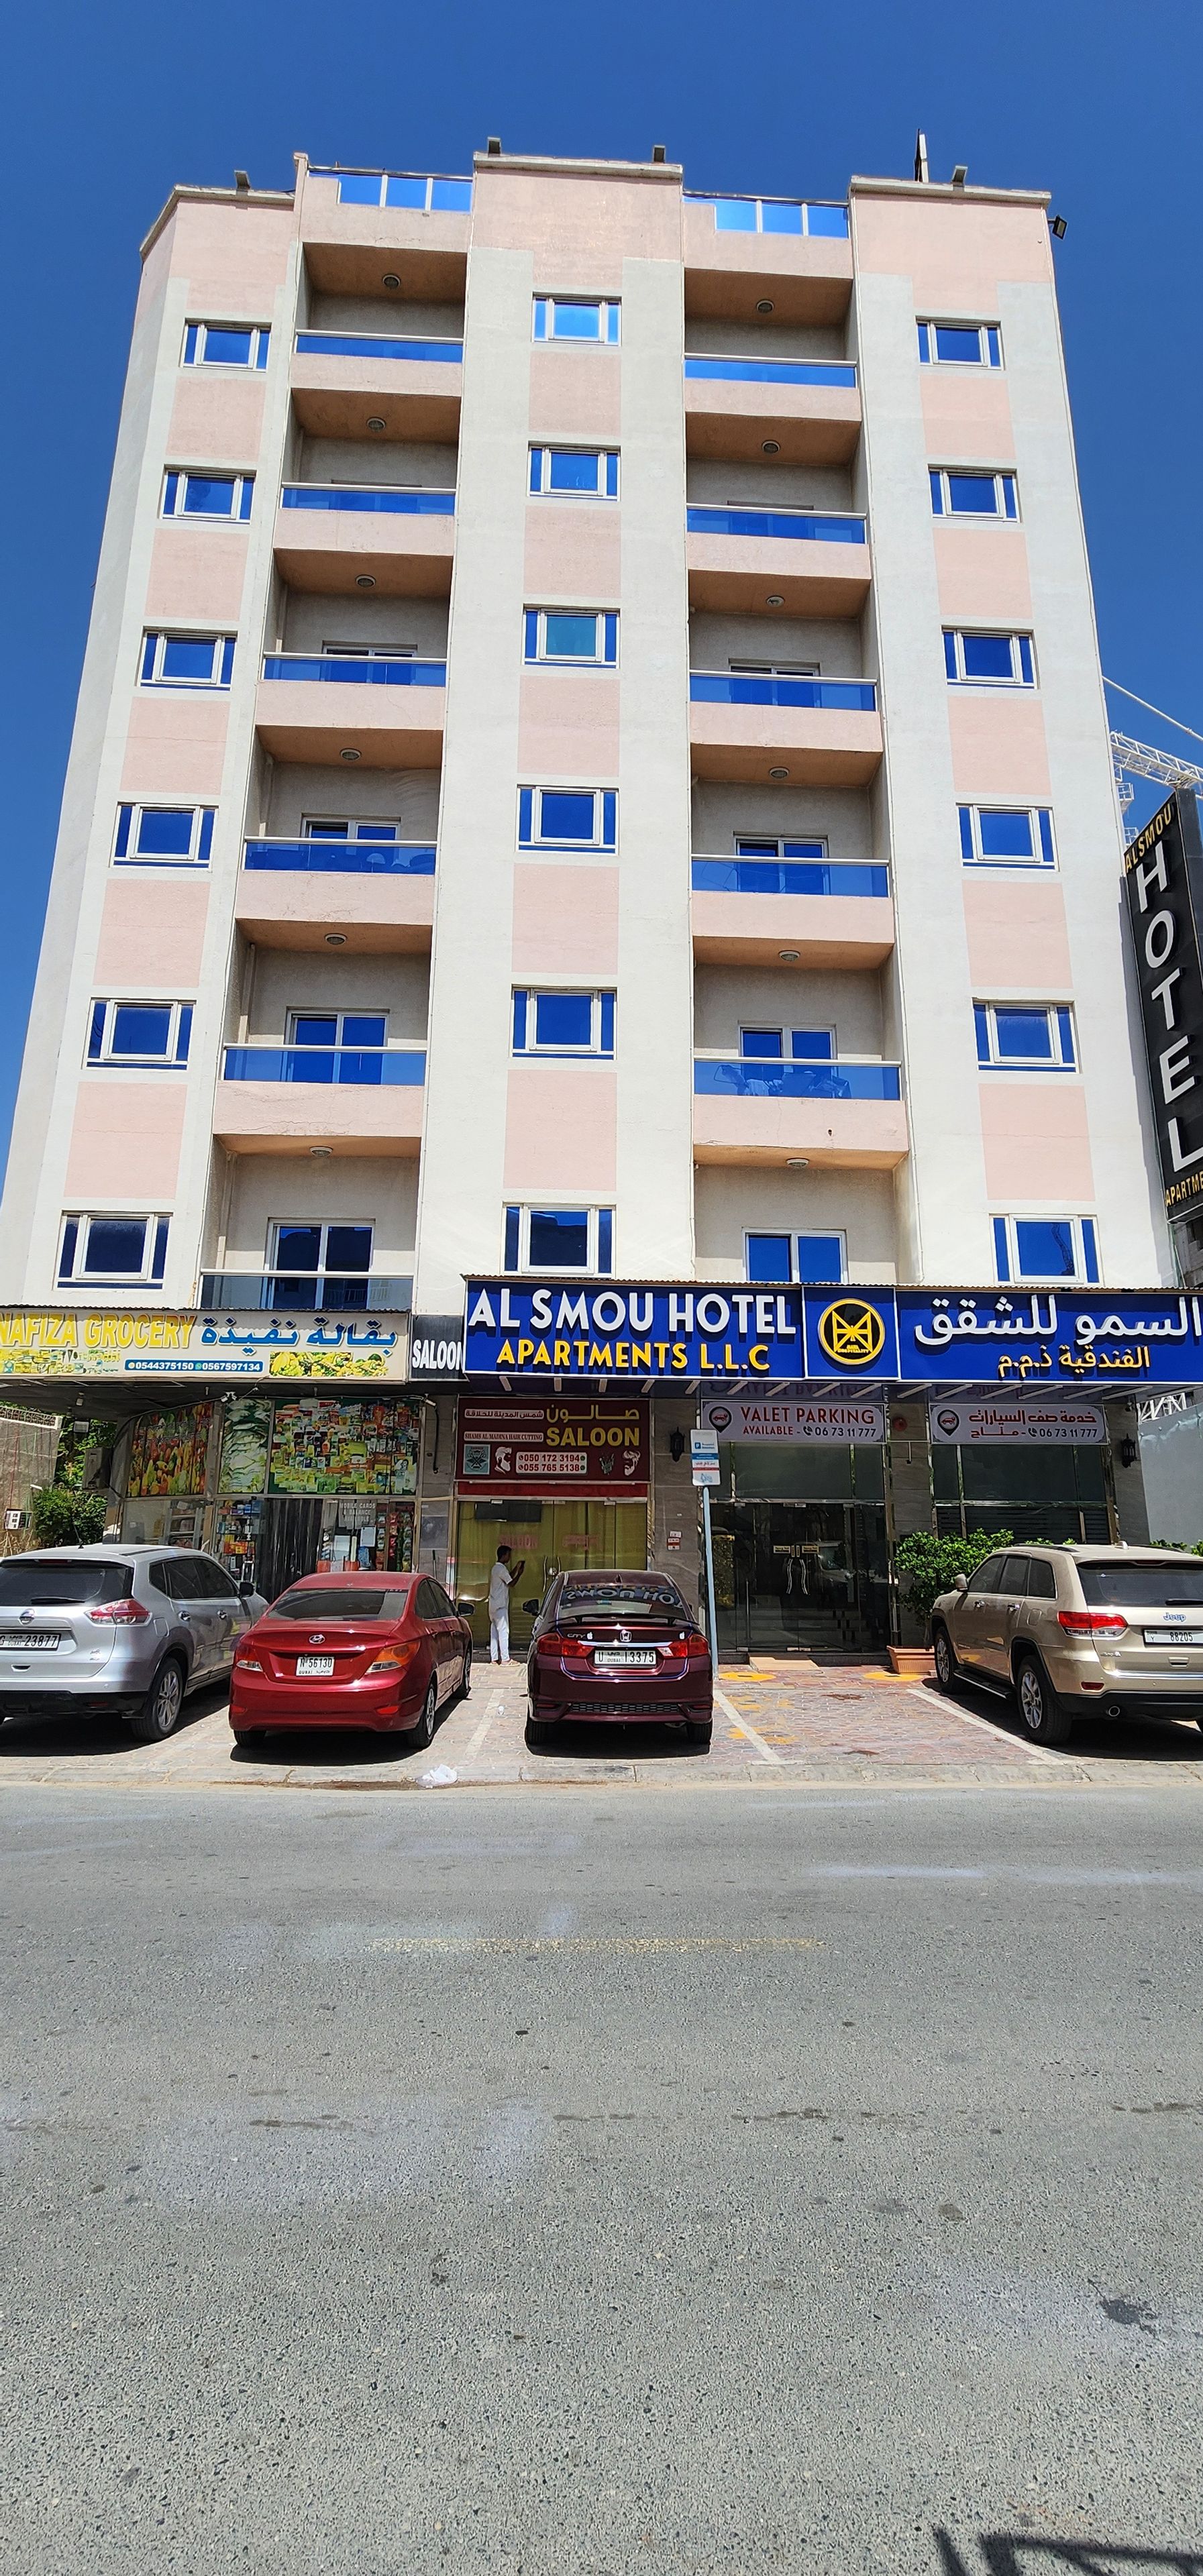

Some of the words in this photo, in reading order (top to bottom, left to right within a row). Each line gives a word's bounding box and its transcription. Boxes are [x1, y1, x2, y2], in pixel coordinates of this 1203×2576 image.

[1136, 841, 1203, 1172] HOTEL
[468, 1288, 520, 1328] AL
[529, 1289, 653, 1332] SMOU
[668, 1293, 796, 1334] HOTEL
[914, 1295, 1058, 1346] للشقق
[1076, 1297, 1202, 1346] السمو
[0, 1312, 78, 1346] NAFIZA
[85, 1313, 197, 1348] GROCERY
[306, 1316, 398, 1356] بقالة
[413, 1340, 464, 1370] SALOON
[496, 1338, 688, 1369] APARTMENTS
[700, 1344, 770, 1371] L.L.C
[1058, 1344, 1151, 1374] الفندقية
[136, 1361, 194, 1371] 0544375150
[202, 1362, 260, 1371] 0567597134
[493, 1411, 519, 1419] المدينة
[519, 1410, 543, 1419] شمس
[741, 1407, 790, 1422] VALET
[796, 1409, 874, 1425] PARKING
[968, 1409, 1027, 1426] السيارات
[1028, 1410, 1058, 1423] صف
[1059, 1410, 1097, 1423] خدمة
[546, 1428, 639, 1447] SALOON
[743, 1426, 794, 1436] AVAILABLE
[815, 1427, 829, 1436] 06
[831, 1428, 844, 1437] 73
[847, 1428, 855, 1437] 11
[857, 1428, 877, 1438] 777
[1039, 1428, 1053, 1437] 06
[1055, 1428, 1067, 1438] 73
[1069, 1429, 1078, 1438] 11
[1081, 1428, 1098, 1438] 777
[524, 1454, 539, 1462] 050
[542, 1454, 558, 1462] 172
[560, 1464, 580, 1472] 5138
[1163, 1612, 1186, 1622] Jeep
[24, 1635, 58, 1647] 23877
[1169, 1631, 1194, 1642] 88205
[598, 1652, 604, 1662] U
[625, 1652, 654, 1663] 13375
